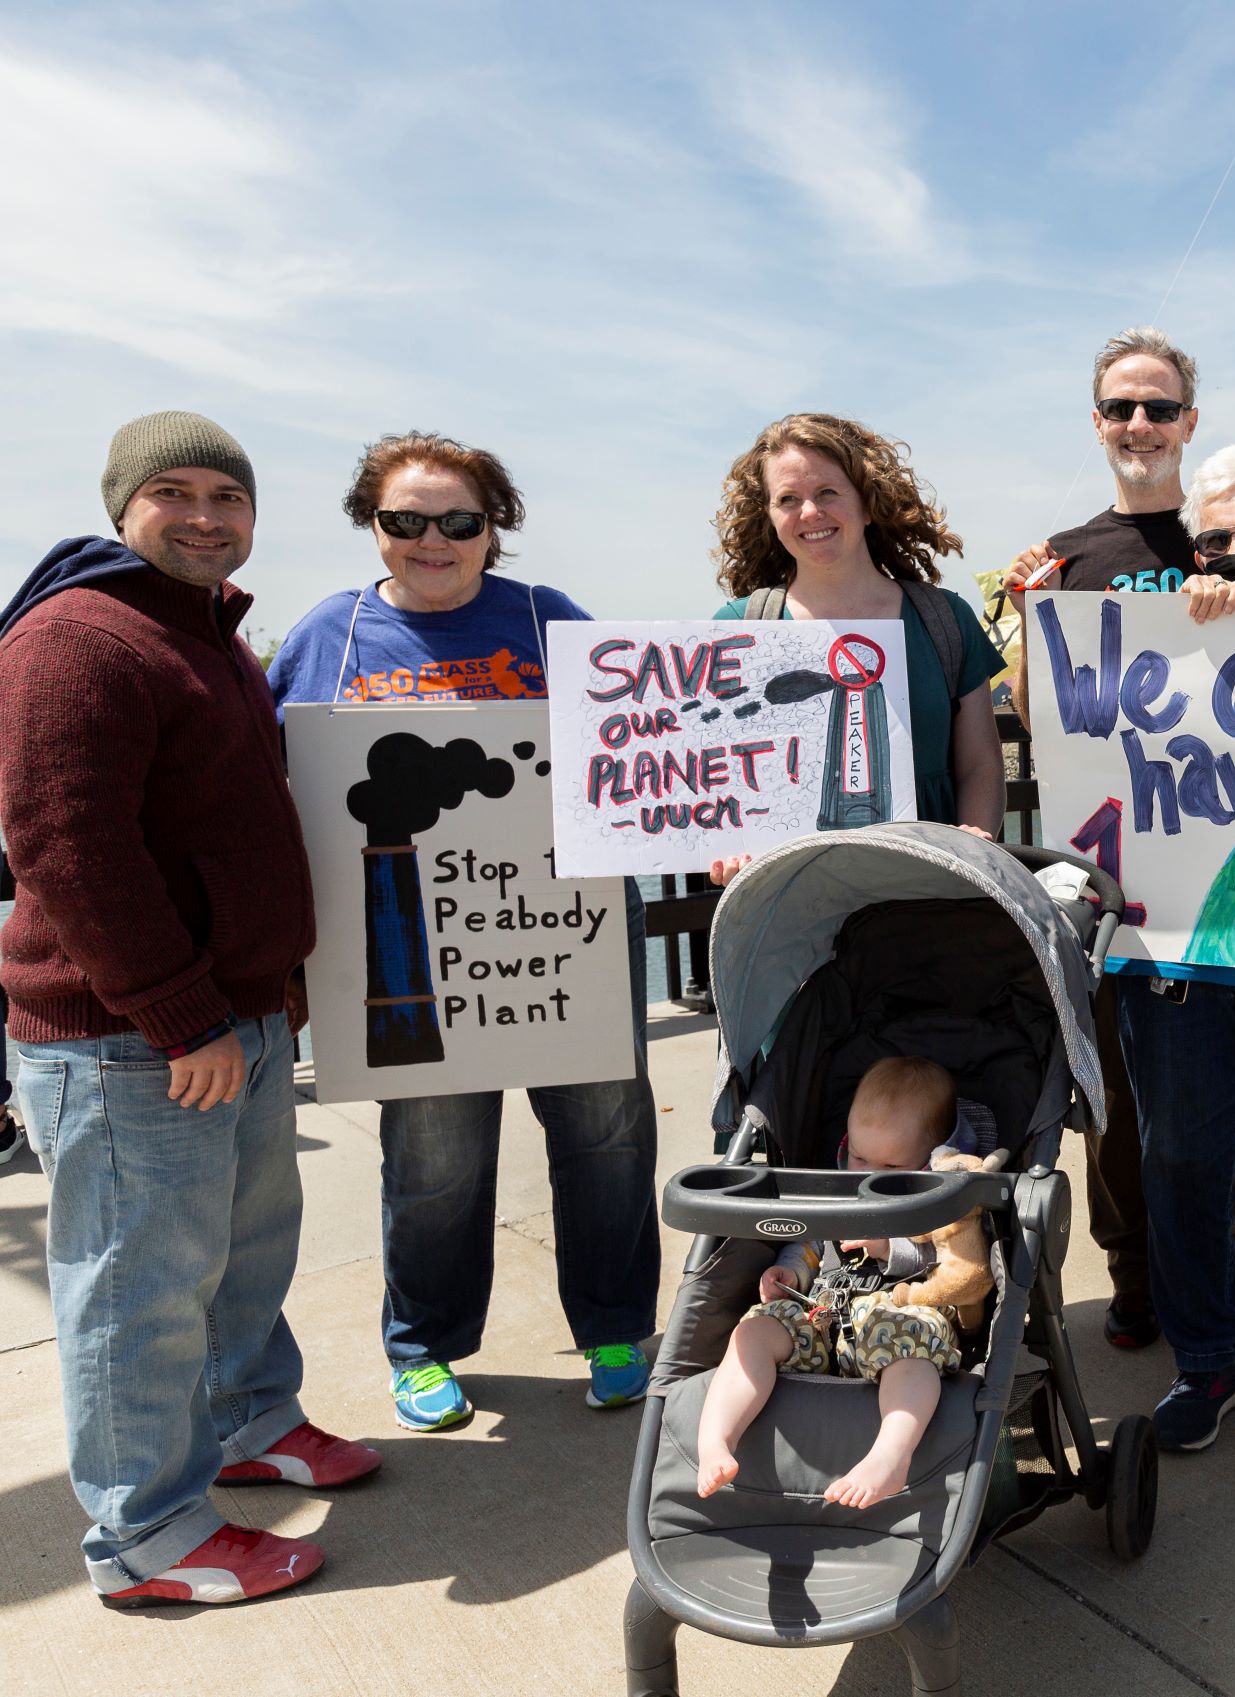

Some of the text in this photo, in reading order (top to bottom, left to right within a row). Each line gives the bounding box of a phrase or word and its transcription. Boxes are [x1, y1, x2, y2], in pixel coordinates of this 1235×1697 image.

[425, 660, 492, 680] MASS
[465, 676, 481, 685] for
[586, 634, 757, 704] SAVE
[1035, 598, 1193, 740] We
[599, 708, 682, 750] OUR
[848, 693, 863, 788] PEAKER
[432, 849, 519, 900] Stop
[1068, 796, 1147, 928] 1
[434, 890, 608, 944] Peabody
[439, 946, 572, 982] Power
[444, 987, 571, 1029] Plant
[764, 1222, 801, 1233] GRACO
